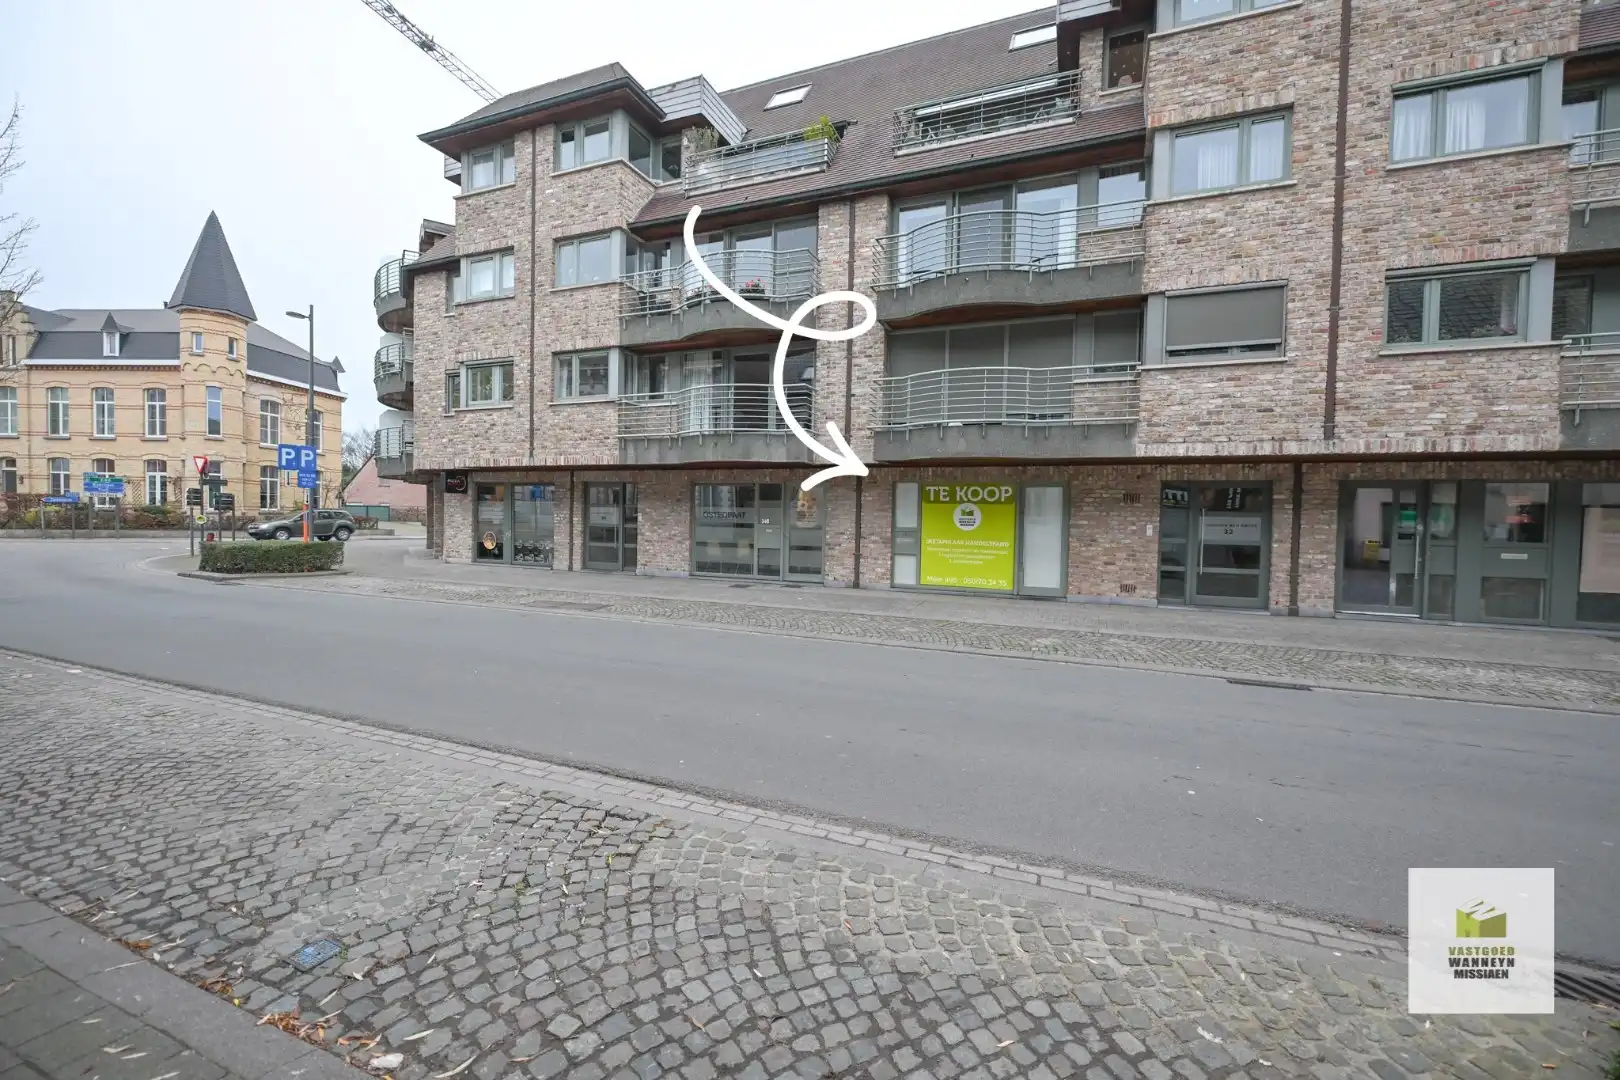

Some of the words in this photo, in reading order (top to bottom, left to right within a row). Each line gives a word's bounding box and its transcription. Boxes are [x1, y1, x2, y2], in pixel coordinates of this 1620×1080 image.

[282, 448, 296, 466] P
[301, 449, 315, 468] P
[926, 486, 950, 502] TE
[956, 486, 1013, 502] KOOP
